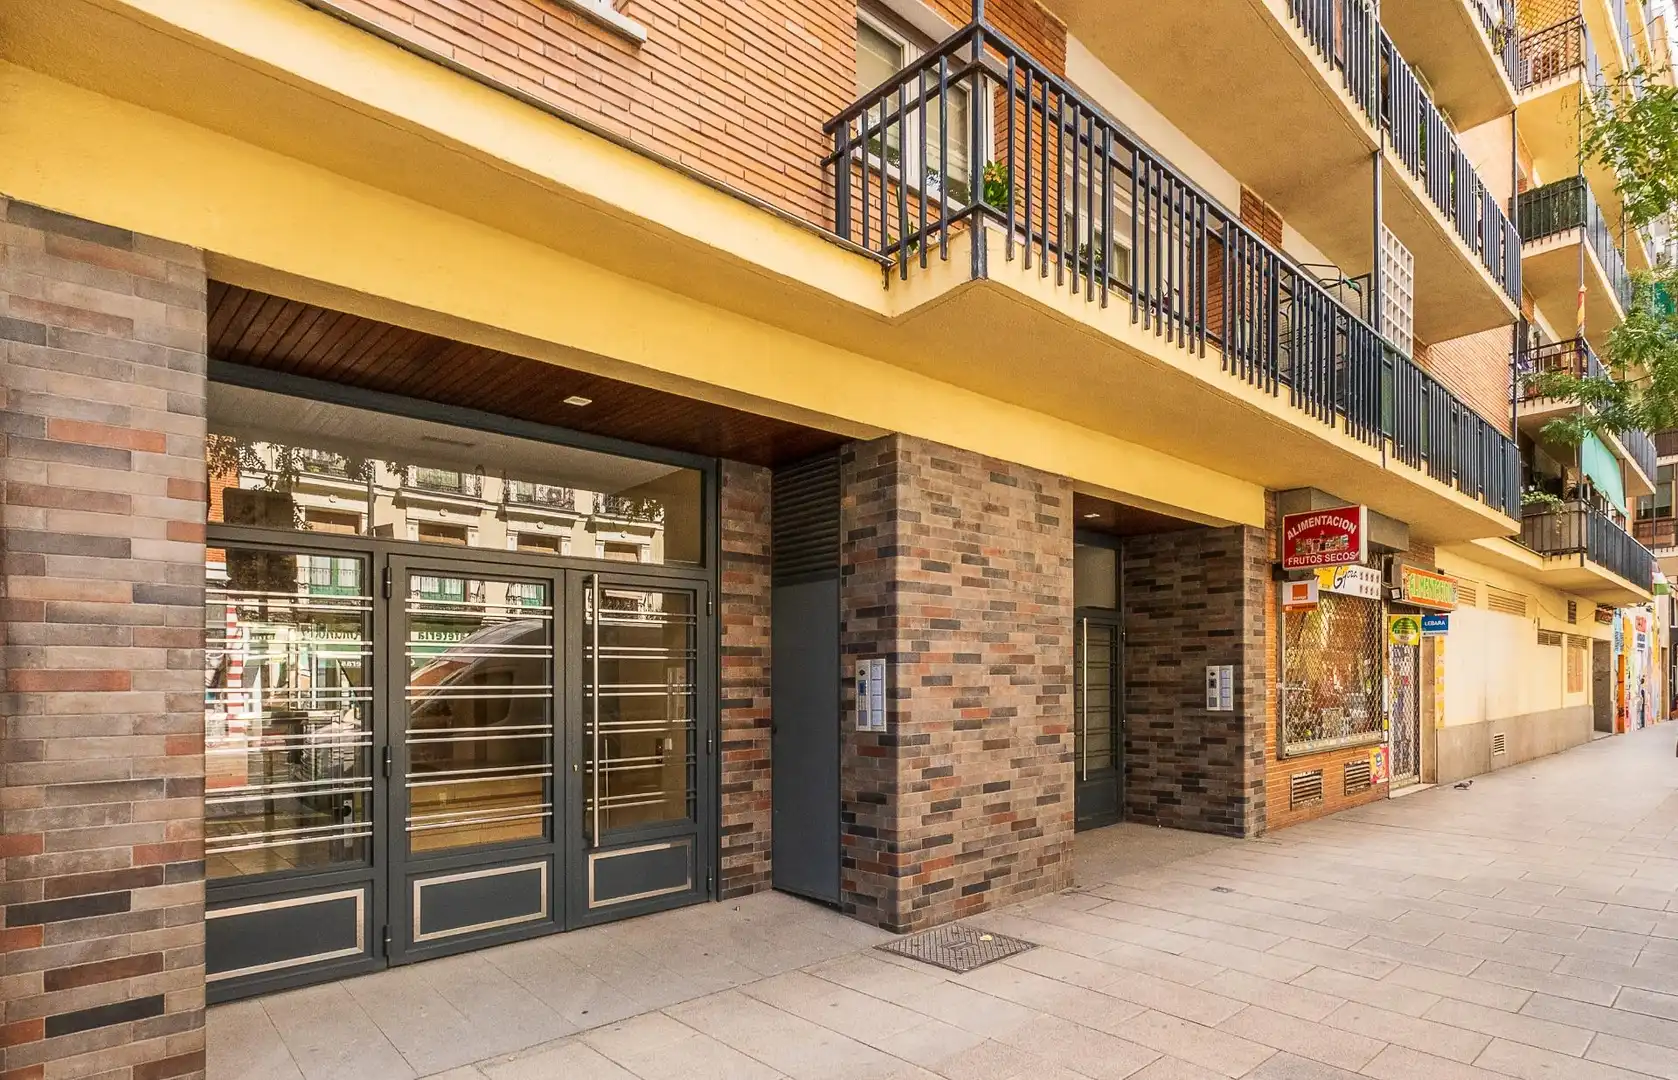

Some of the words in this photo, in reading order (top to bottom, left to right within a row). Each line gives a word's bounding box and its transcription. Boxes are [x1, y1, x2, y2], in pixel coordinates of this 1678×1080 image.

[1287, 515, 1357, 540] ALIMENTACION
[1288, 555, 1323, 566] FRUTOS
[1324, 551, 1356, 563] SECOS
